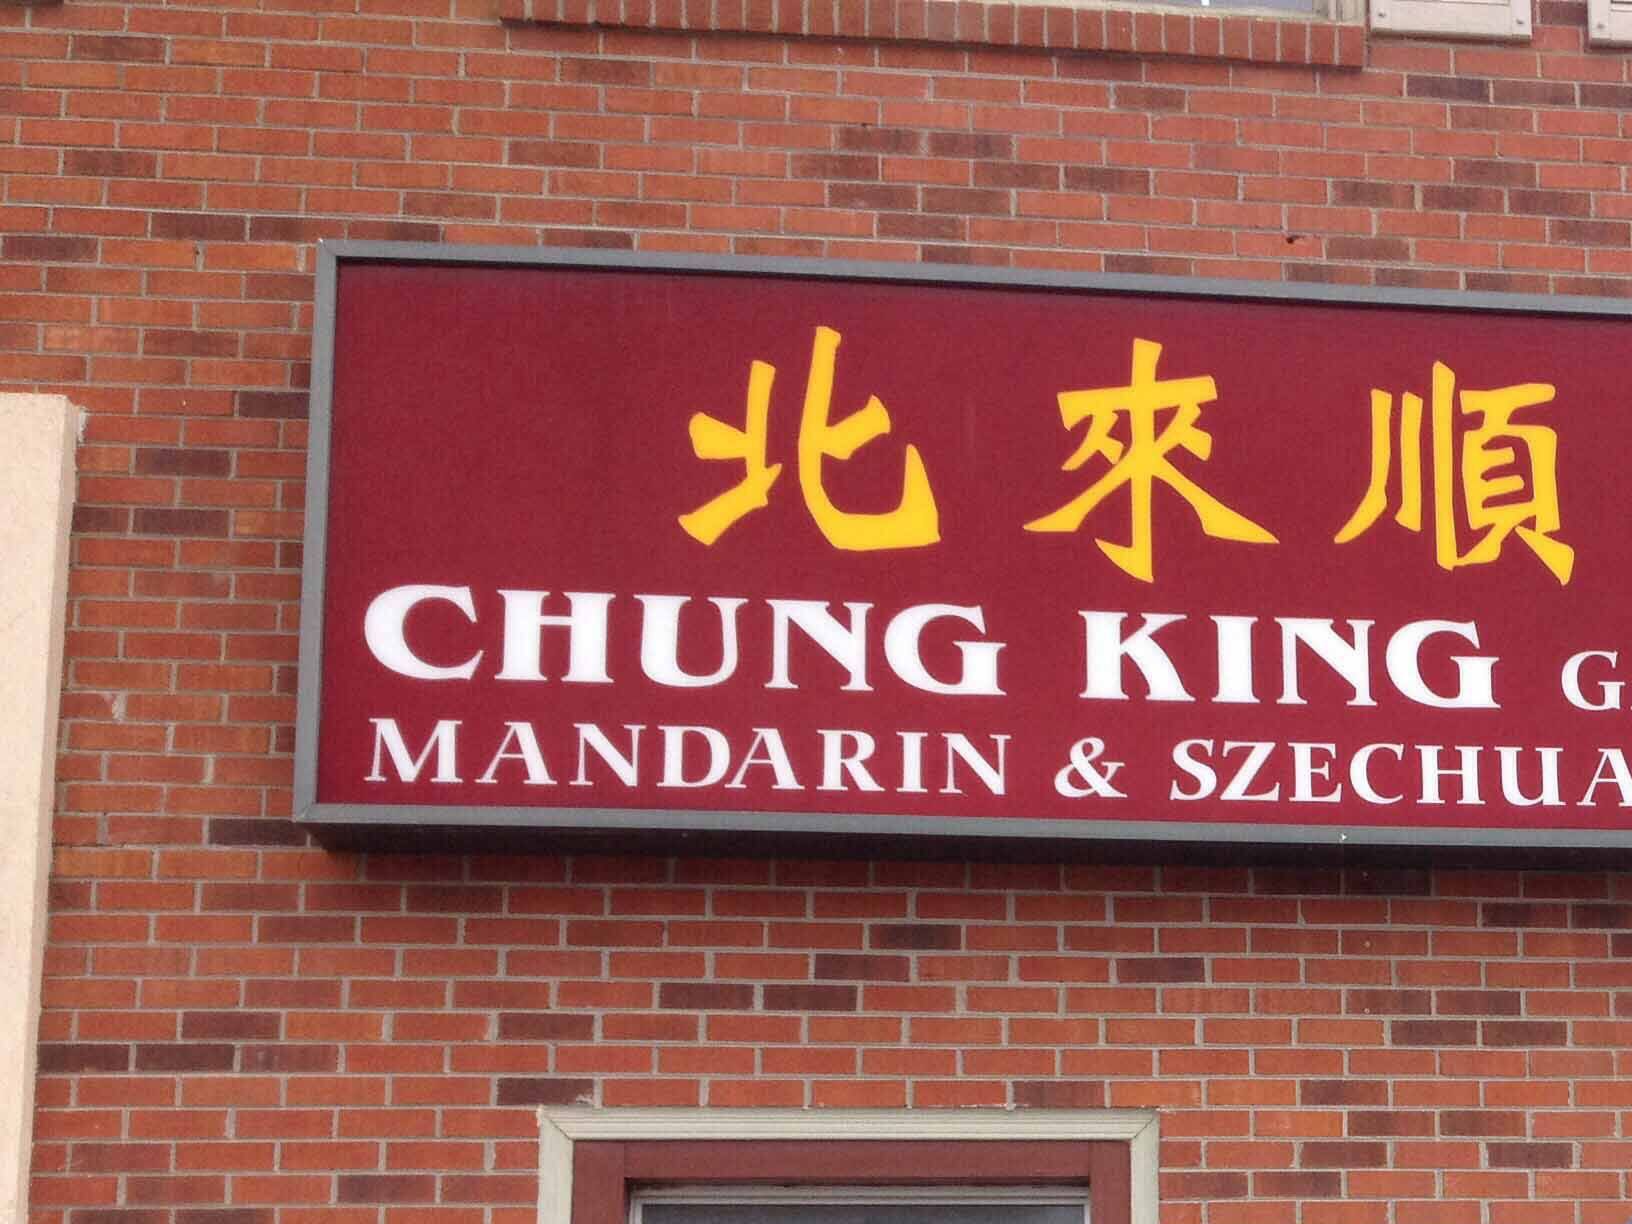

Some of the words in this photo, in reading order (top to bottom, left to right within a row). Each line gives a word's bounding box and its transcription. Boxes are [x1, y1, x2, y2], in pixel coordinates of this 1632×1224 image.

[678, 325, 1576, 586] 北來順
[364, 583, 1007, 696] CHUNG
[1078, 610, 1501, 709] KING
[364, 717, 1012, 796] MANDARIN
[1054, 736, 1128, 799] &
